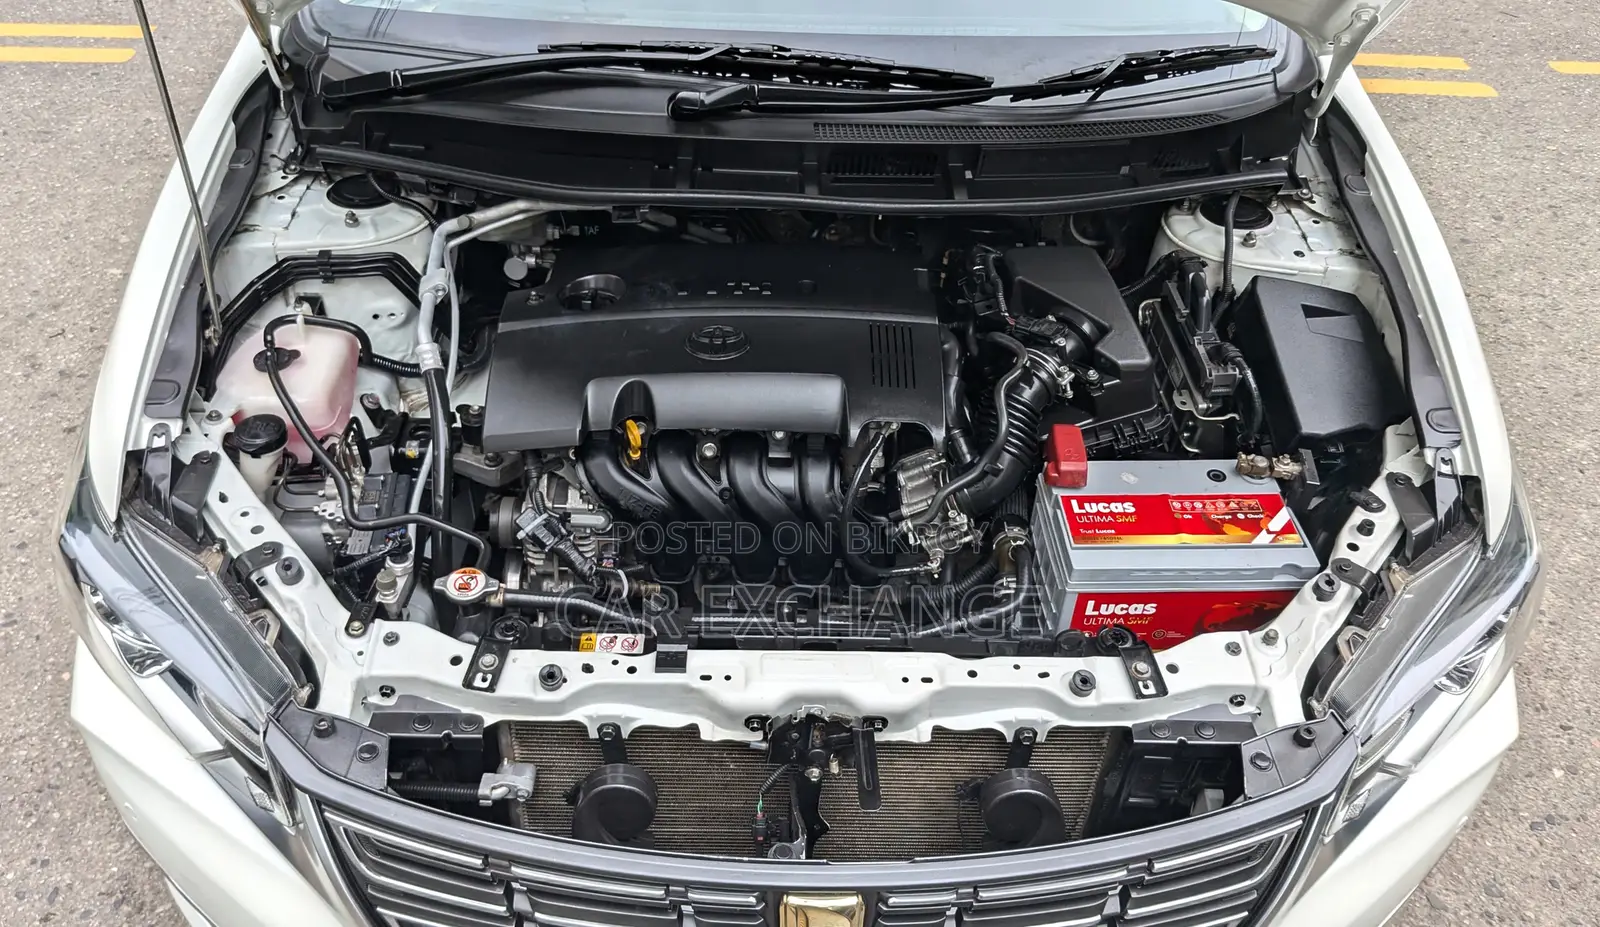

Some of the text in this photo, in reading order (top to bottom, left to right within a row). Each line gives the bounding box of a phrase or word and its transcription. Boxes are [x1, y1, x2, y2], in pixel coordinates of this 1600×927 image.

[1070, 499, 1136, 514] Lucas
[1076, 515, 1137, 523] ULTIMA SMF
[1085, 600, 1157, 615] Lucas
[1083, 616, 1153, 625] ULTIMA SMF
